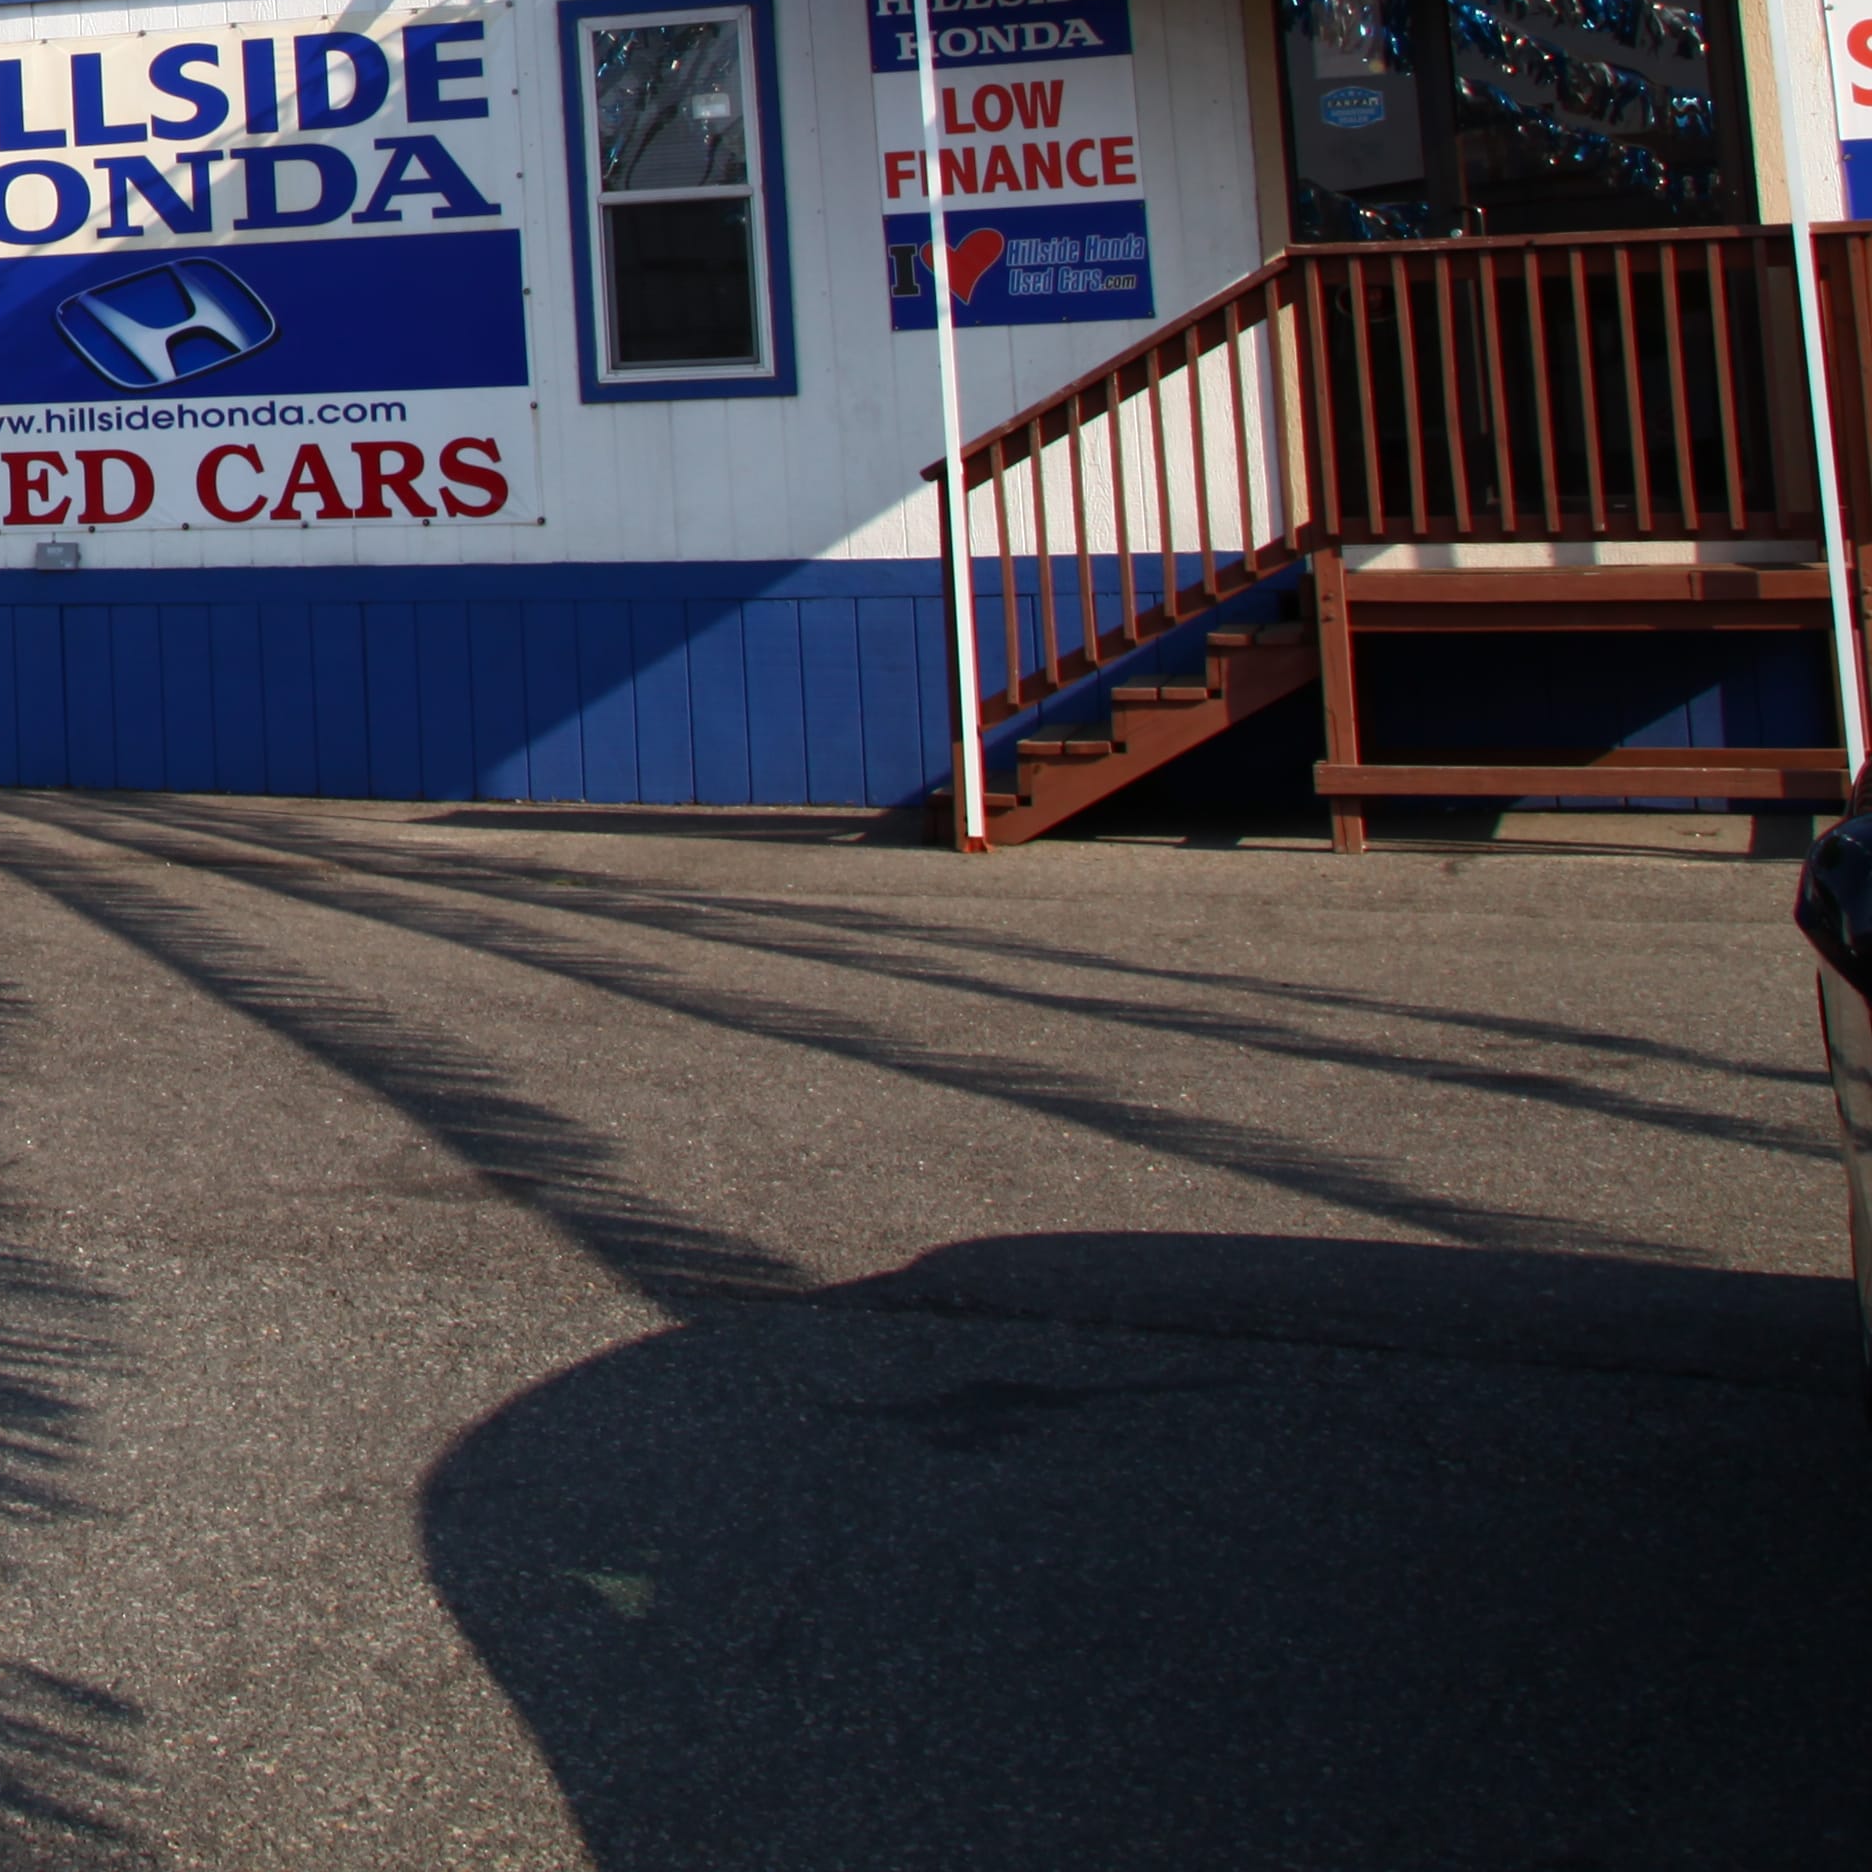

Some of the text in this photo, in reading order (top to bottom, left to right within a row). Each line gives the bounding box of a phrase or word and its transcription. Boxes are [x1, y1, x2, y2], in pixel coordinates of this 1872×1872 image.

[942, 79, 1064, 135] LOW
[889, 234, 1145, 297] I Hillside Honda
[1008, 268, 1053, 296] Used
[194, 436, 509, 523] CARS
